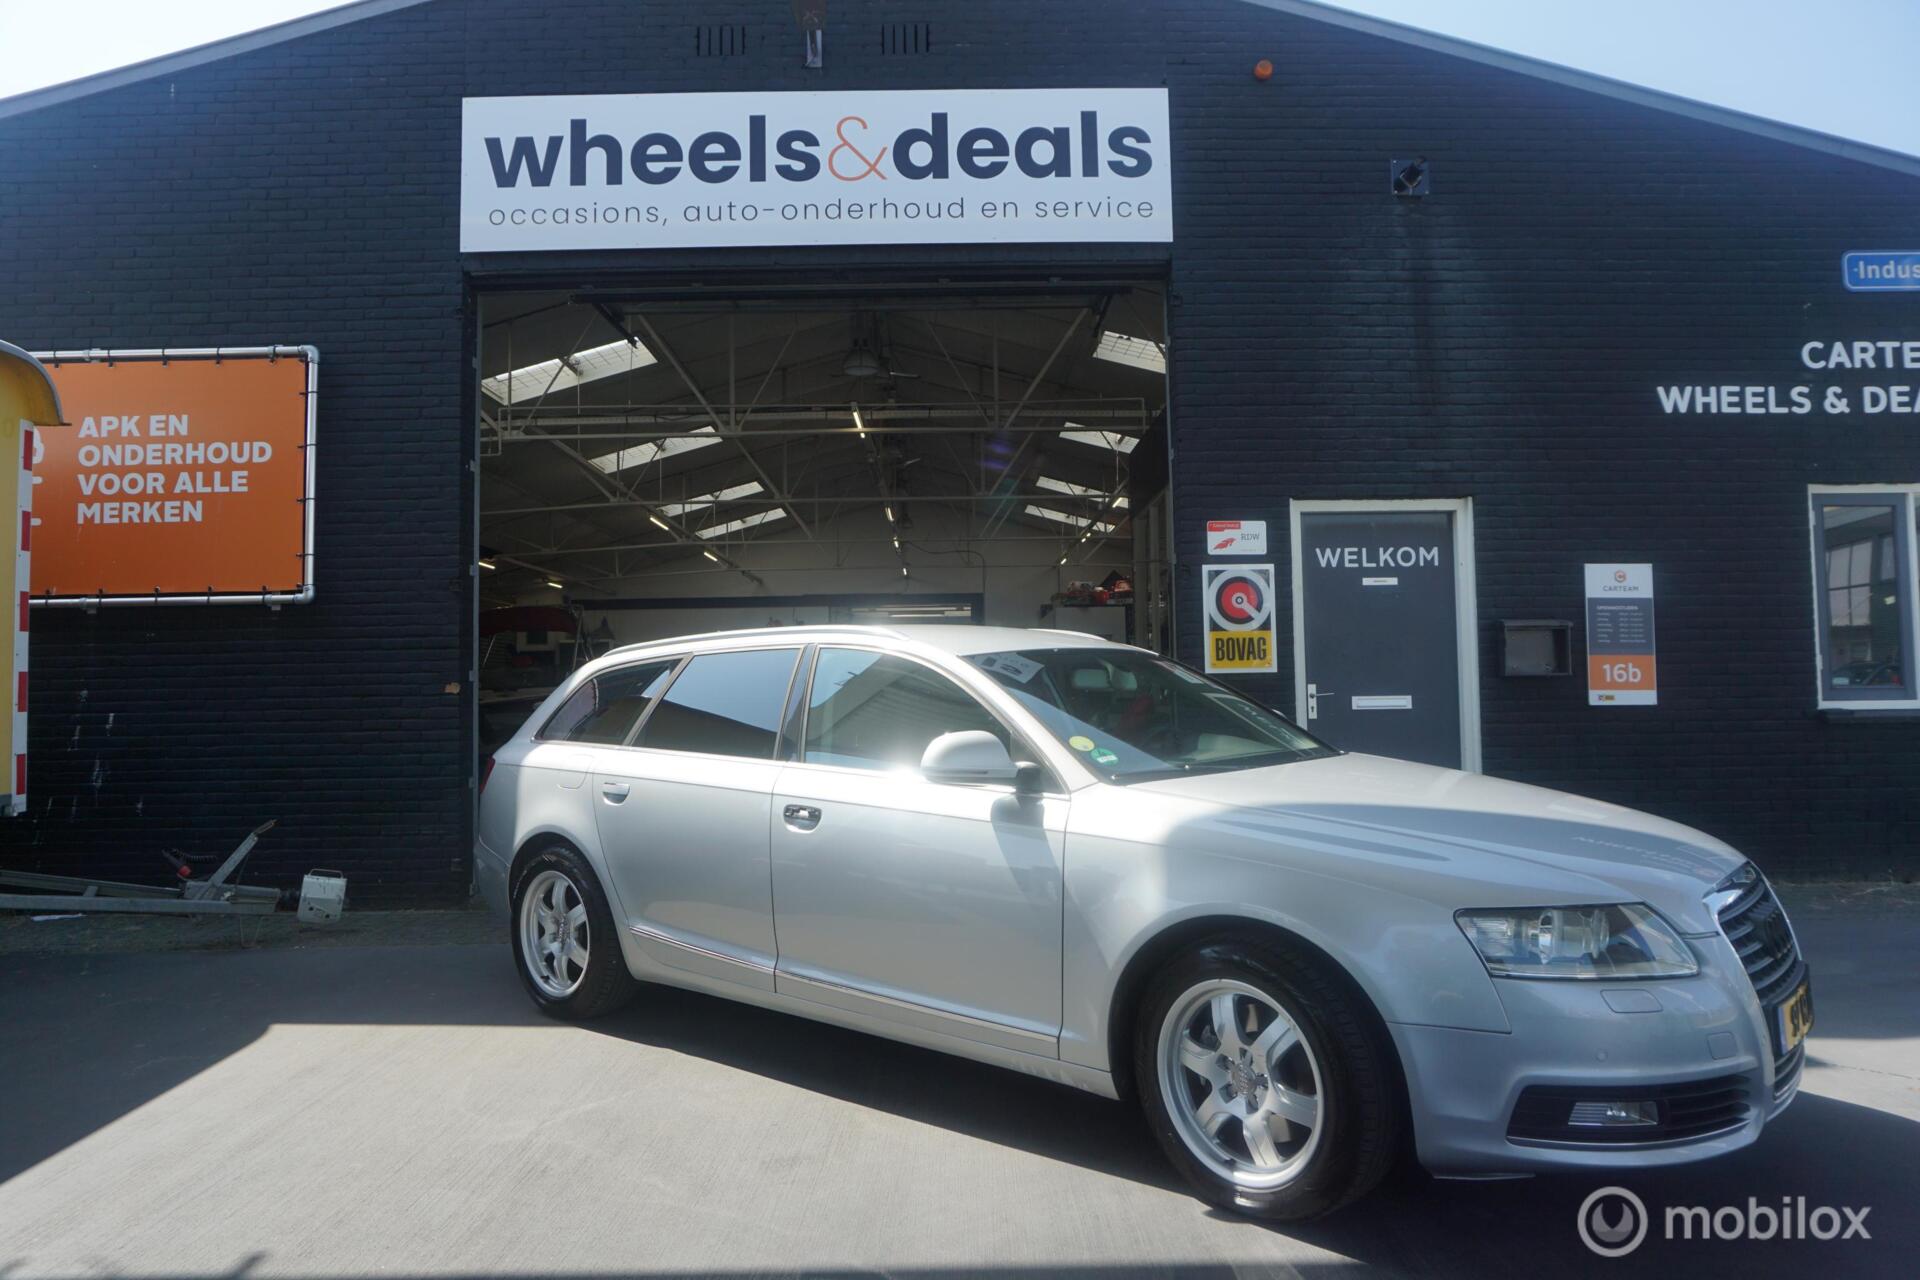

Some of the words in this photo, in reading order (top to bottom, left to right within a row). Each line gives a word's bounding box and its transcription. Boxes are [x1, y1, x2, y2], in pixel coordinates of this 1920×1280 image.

[489, 203, 668, 227] occasions,
[683, 197, 965, 222] auto-onderhoud
[981, 201, 1019, 219] en
[1035, 196, 1154, 219] service
[1801, 341, 1920, 369] CARTE
[1657, 386, 1812, 414] WHEELS
[1824, 386, 1850, 413] &
[1863, 386, 1920, 413] DE
[79, 416, 140, 438] APK
[149, 414, 189, 437] EN
[77, 441, 273, 467] ONDERHOUD
[77, 472, 164, 495] VOOR
[173, 471, 249, 493] ALLE
[77, 500, 203, 524] MERKEN
[1315, 546, 1440, 568] WELKOM
[1215, 637, 1268, 662] BOVAG
[1603, 662, 1642, 683] 16b
